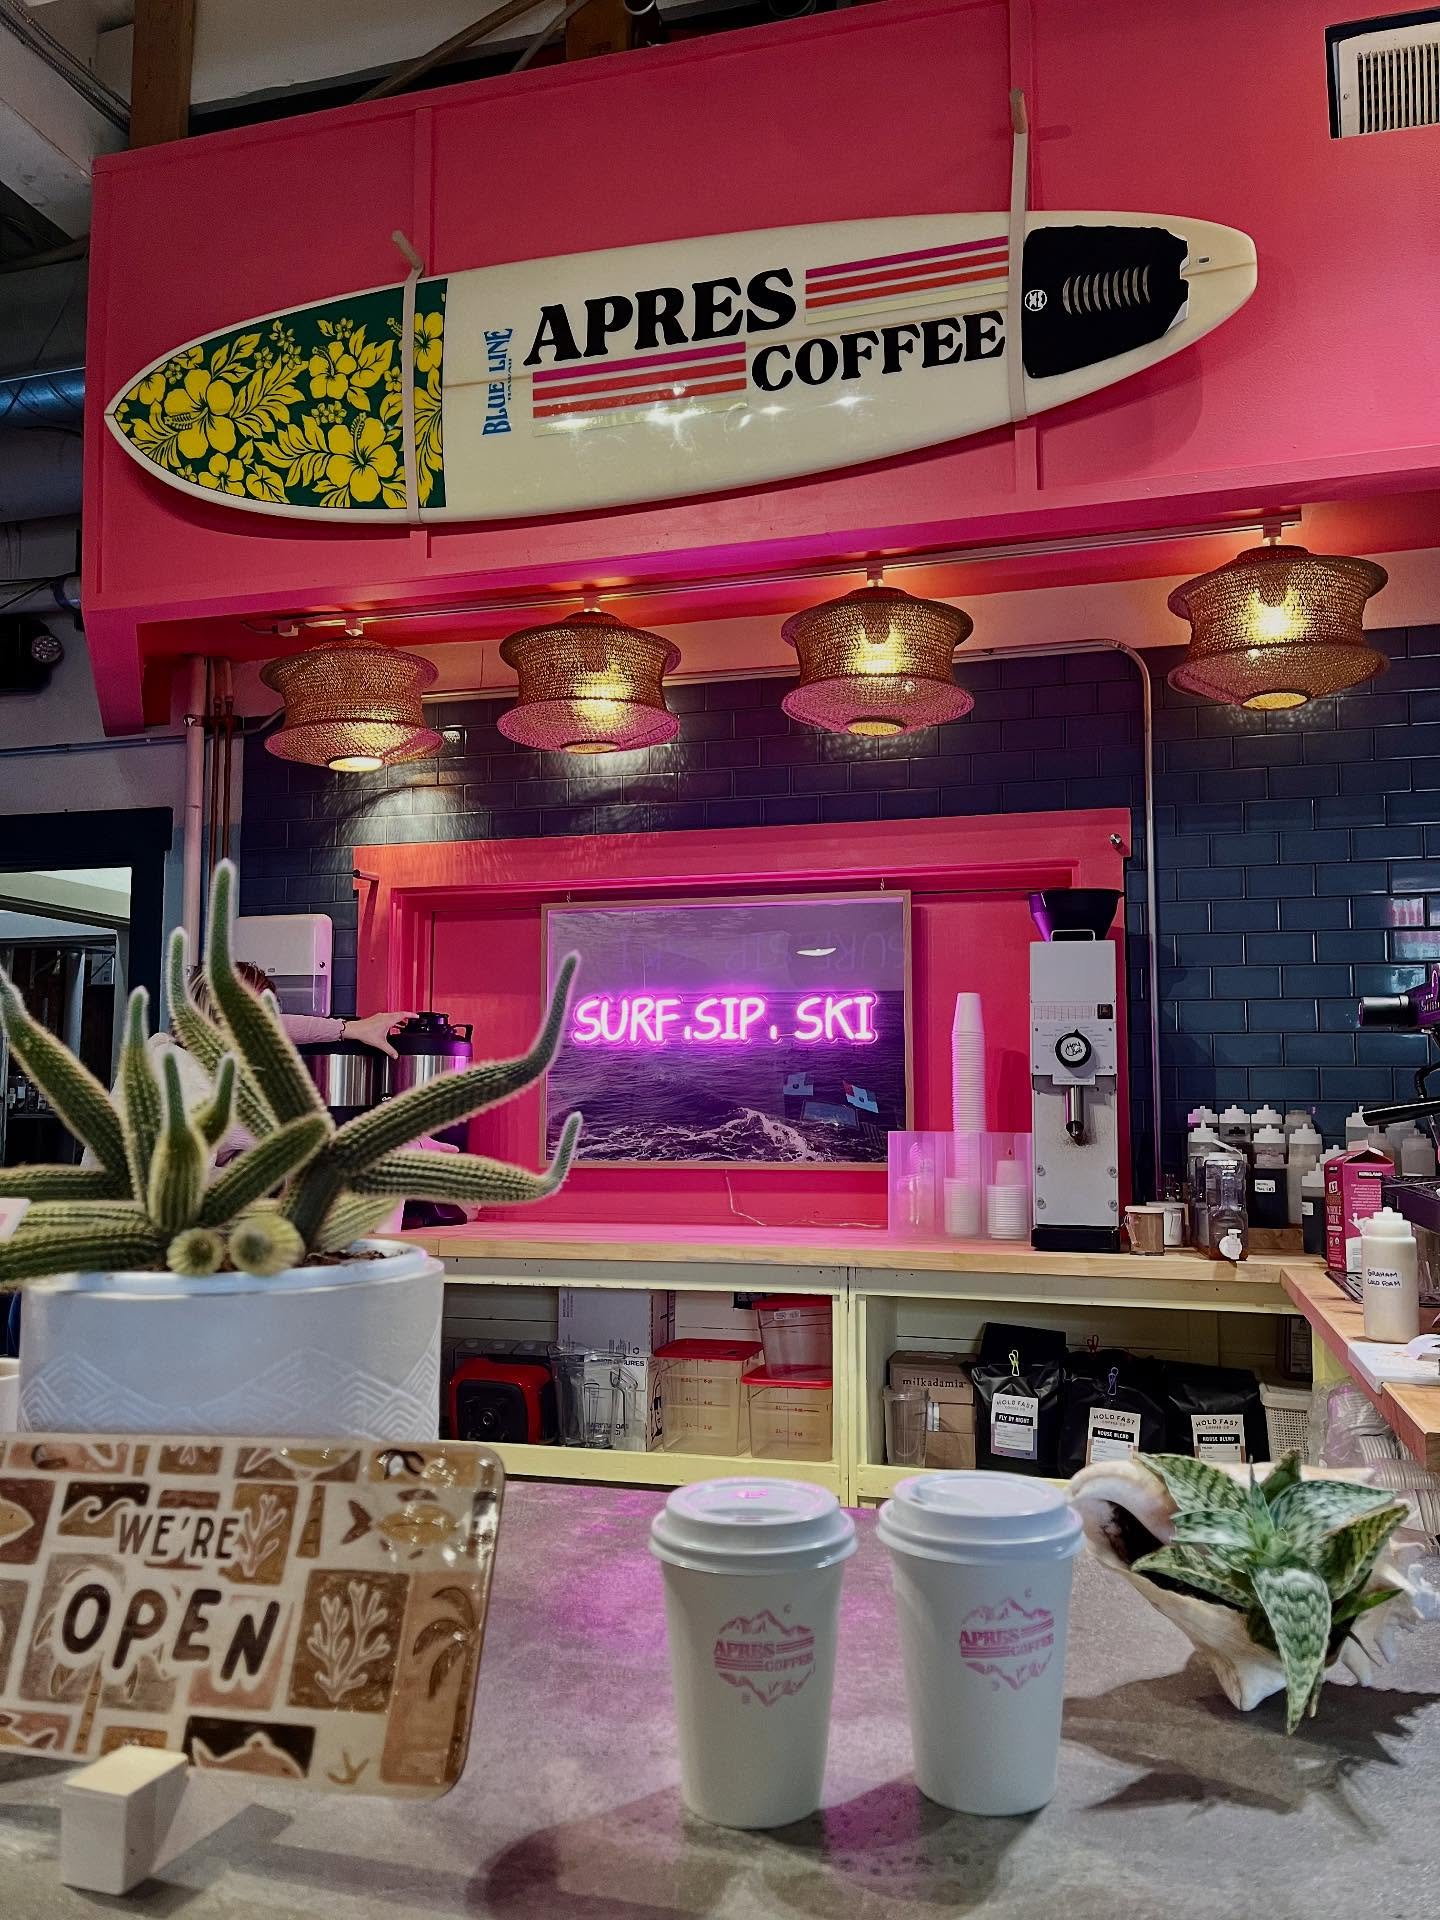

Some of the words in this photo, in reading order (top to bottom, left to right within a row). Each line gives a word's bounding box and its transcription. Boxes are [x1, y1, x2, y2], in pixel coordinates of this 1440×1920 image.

[523, 267, 797, 366] APRES
[484, 328, 513, 372] LINE
[752, 310, 1005, 391] COFFEE
[481, 381, 512, 435] BLUE
[794, 995, 873, 1041] SKI
[902, 1377, 965, 1388] milkadamia
[1017, 1400, 1034, 1410] FAST
[1116, 1415, 1135, 1425] FAST
[1113, 1432, 1130, 1440] BLEND
[1195, 1418, 1217, 1427] HOLD
[1219, 1418, 1239, 1427] FAST
[118, 1513, 240, 1560] WE'RE
[62, 1583, 281, 1682] OPEN
[959, 1628, 1020, 1646] APRES
[714, 1640, 776, 1659] APRES
